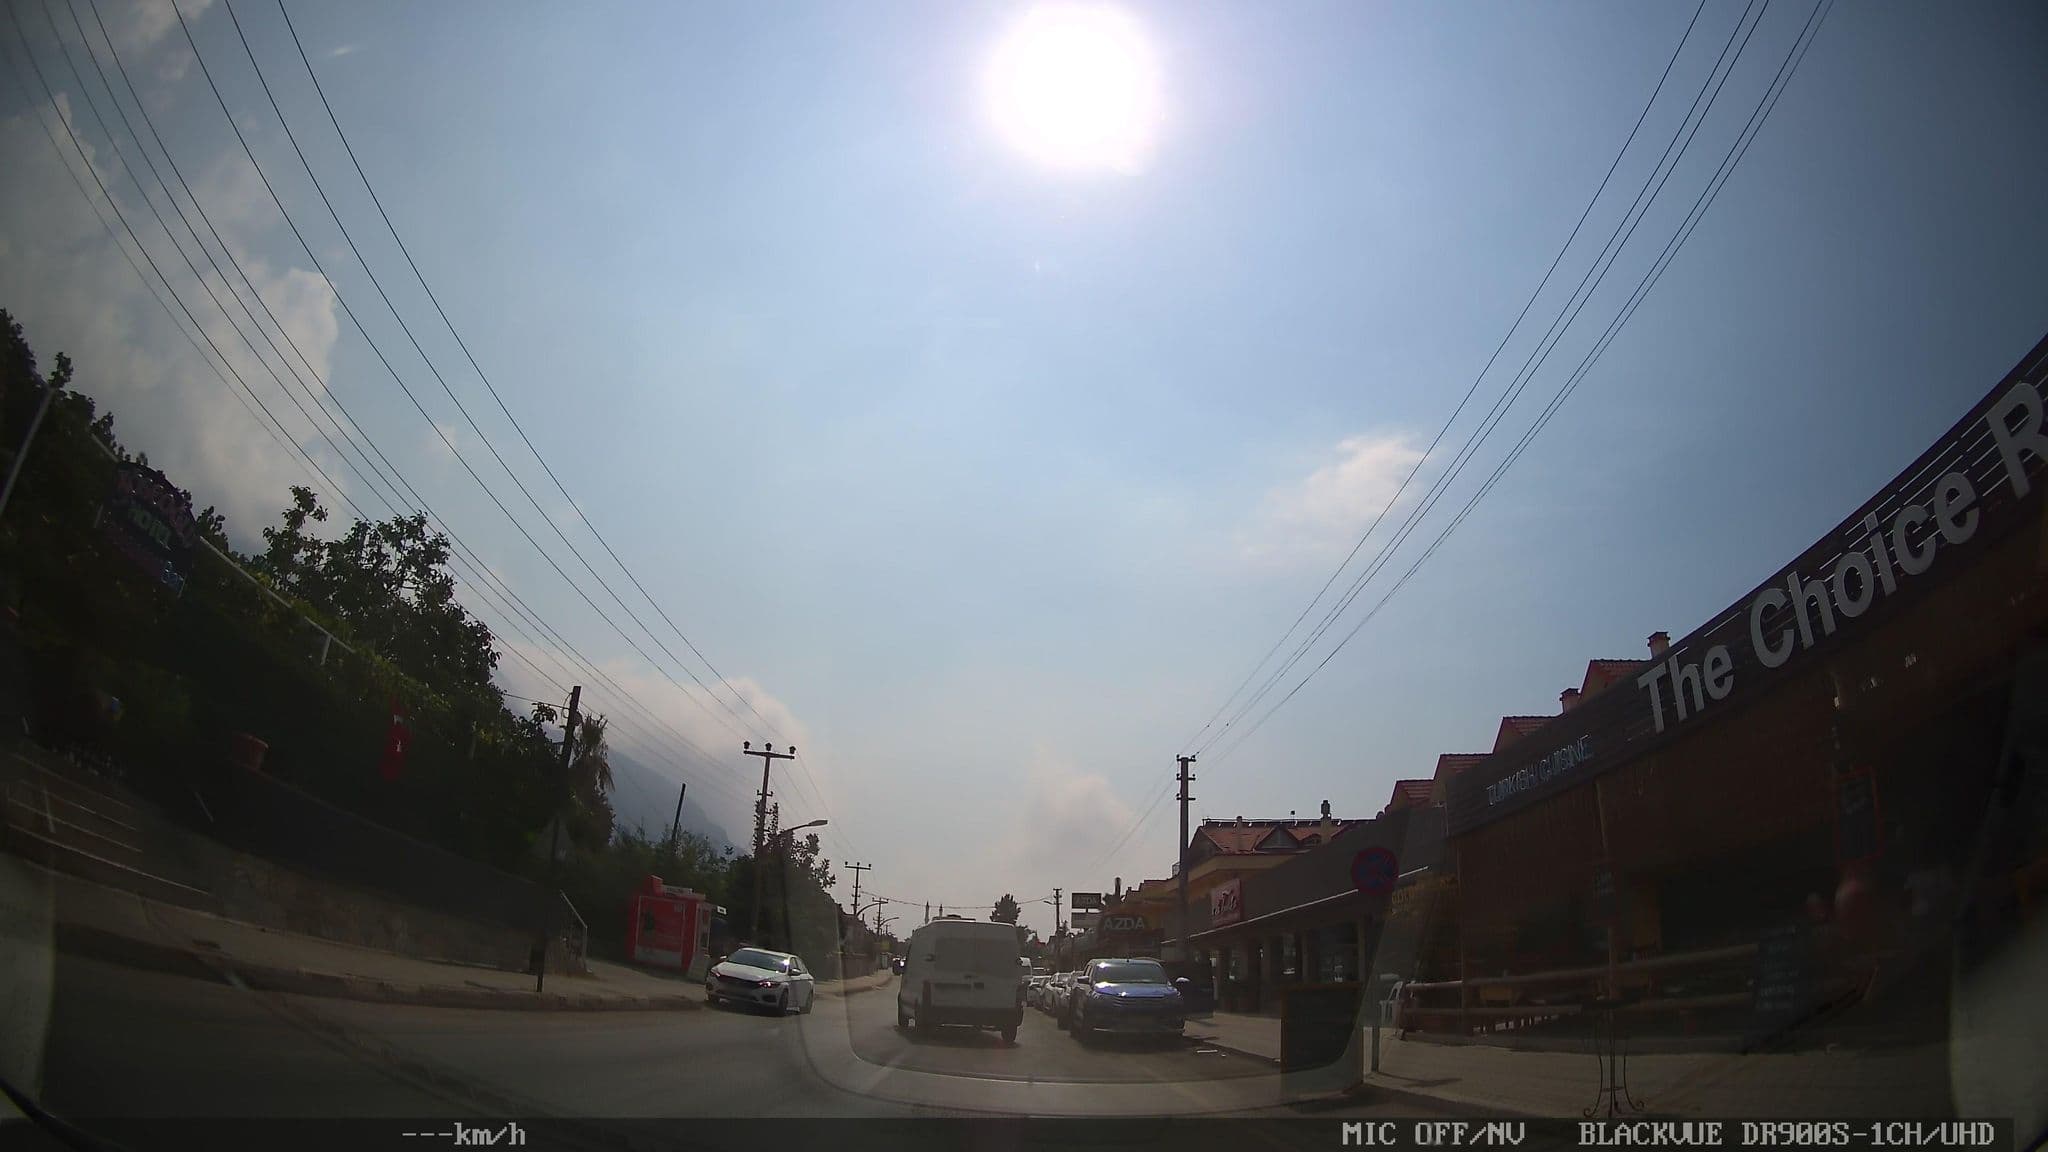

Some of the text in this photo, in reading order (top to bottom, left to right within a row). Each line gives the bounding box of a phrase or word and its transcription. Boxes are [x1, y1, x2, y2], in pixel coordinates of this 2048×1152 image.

[1638, 650, 1736, 733] The
[1748, 470, 1981, 670] Choice
[1486, 733, 1592, 805] TURKISH CUISINE
[1103, 916, 1145, 931] AZDA
